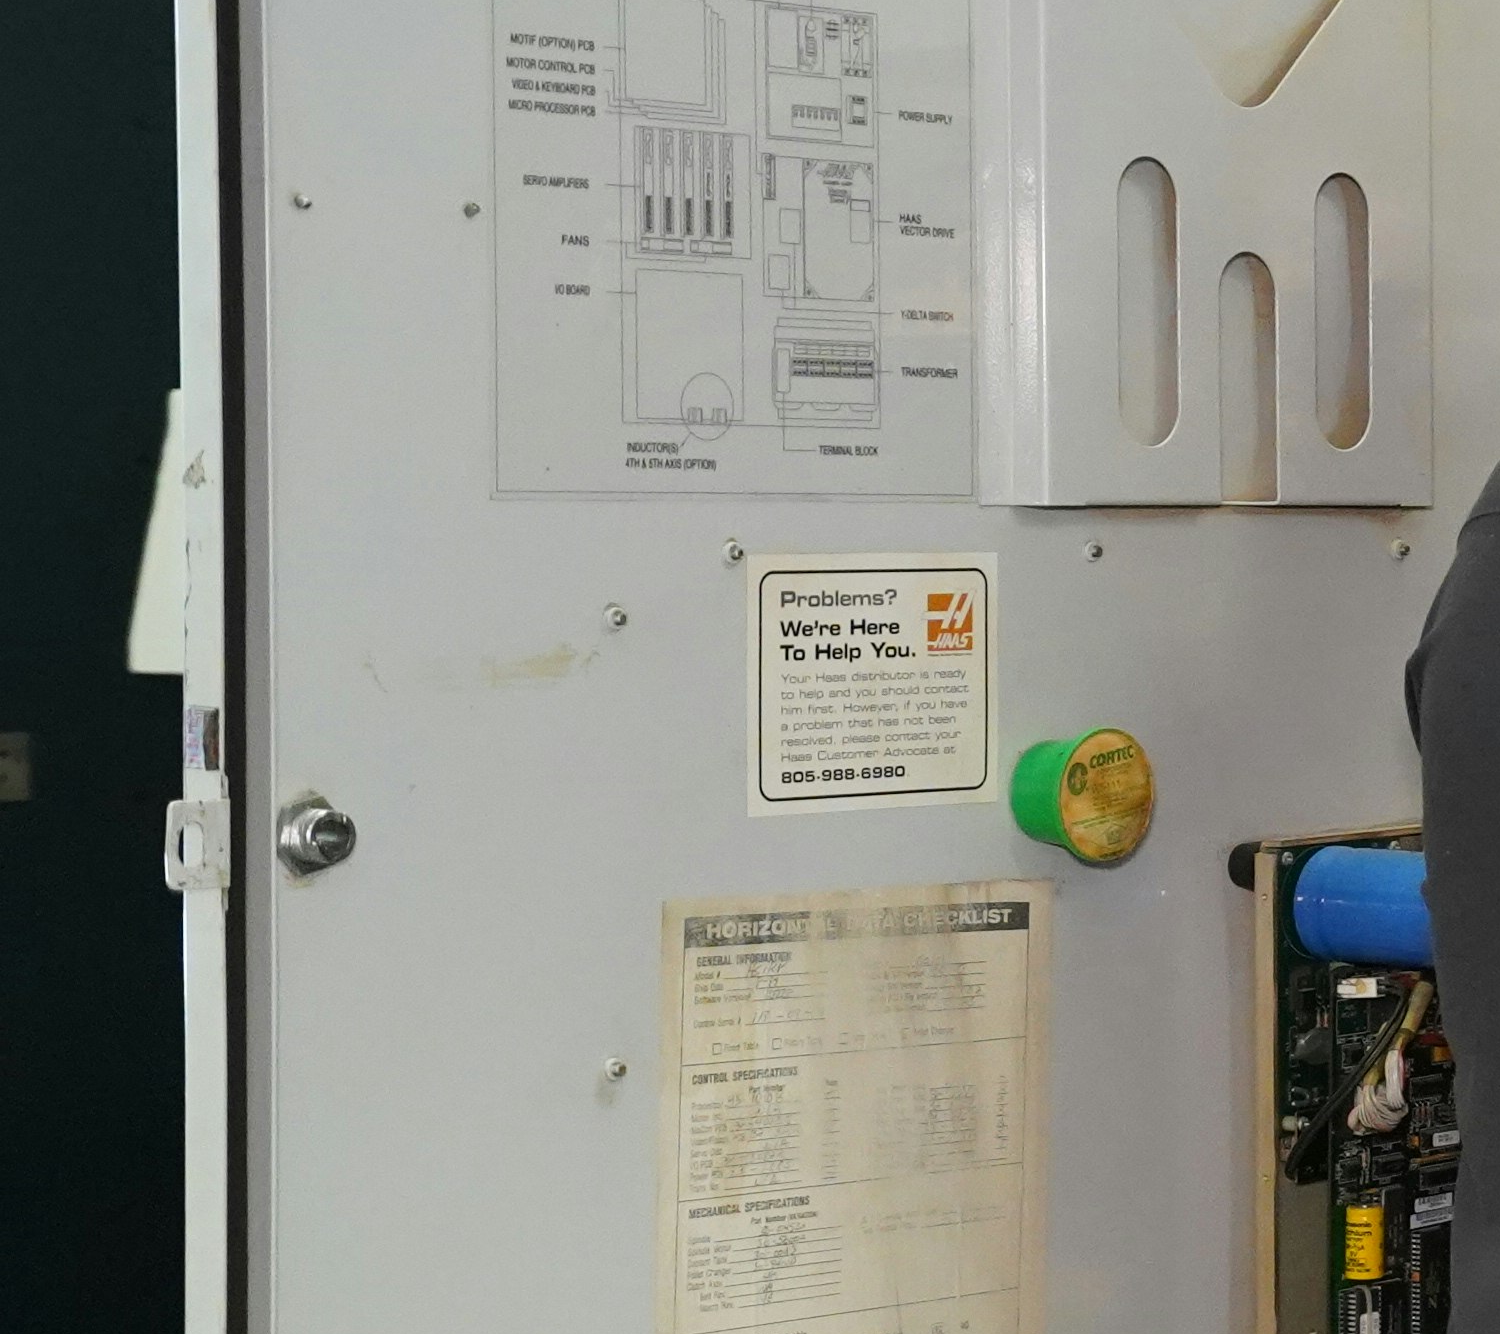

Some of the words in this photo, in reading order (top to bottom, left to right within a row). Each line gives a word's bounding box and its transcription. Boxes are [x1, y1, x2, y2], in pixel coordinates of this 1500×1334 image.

[510, 33, 536, 45] MOTIF
[538, 35, 576, 52] (OPTION)
[577, 39, 595, 51] PCB
[506, 56, 536, 70] MOTOR
[538, 59, 577, 74] CONTROL
[578, 63, 595, 75] PCB
[899, 214, 922, 224] HAAS
[561, 234, 590, 246] FANS
[900, 226, 931, 237] VECTOR
[901, 367, 958, 379] TRANSFORMER
[819, 445, 854, 456] TERMINAL
[855, 446, 879, 457] BLOCK
[780, 589, 897, 608] Problems?
[780, 620, 841, 637] We're
[850, 619, 900, 636] Here
[928, 633, 972, 649] HAAS
[780, 644, 806, 661] To
[814, 643, 862, 663] Help
[871, 642, 917, 659] You.
[781, 673, 811, 684] Your
[815, 672, 847, 684] Haas
[851, 670, 916, 683] distributor
[920, 670, 930, 680] is
[933, 669, 967, 681] ready
[781, 690, 795, 700] to
[799, 689, 824, 701] help
[829, 688, 851, 698] and
[856, 688, 877, 700] you
[881, 685, 920, 697] should
[924, 684, 969, 695] contact
[780, 705, 803, 716] him
[842, 702, 898, 715] However,
[904, 701, 911, 711] if
[915, 701, 937, 713] you
[940, 699, 968, 709] have
[780, 723, 789, 732] a
[793, 720, 843, 733] problem
[848, 719, 873, 729] that
[878, 718, 899, 728] has
[903, 717, 924, 727] not
[928, 715, 956, 725] been
[842, 733, 881, 746] please
[884, 731, 931, 742] contact
[935, 730, 962, 742] your
[780, 752, 812, 763] Haas
[817, 749, 879, 762] Customer
[883, 747, 939, 757] Advocate
[943, 746, 956, 756] at
[692, 1071, 728, 1086] CONTROL
[732, 1066, 798, 1083] SPECIFICATIONS
[688, 1204, 741, 1219] MECHANICAL
[744, 1195, 810, 1214] SPECIFICATIONS
